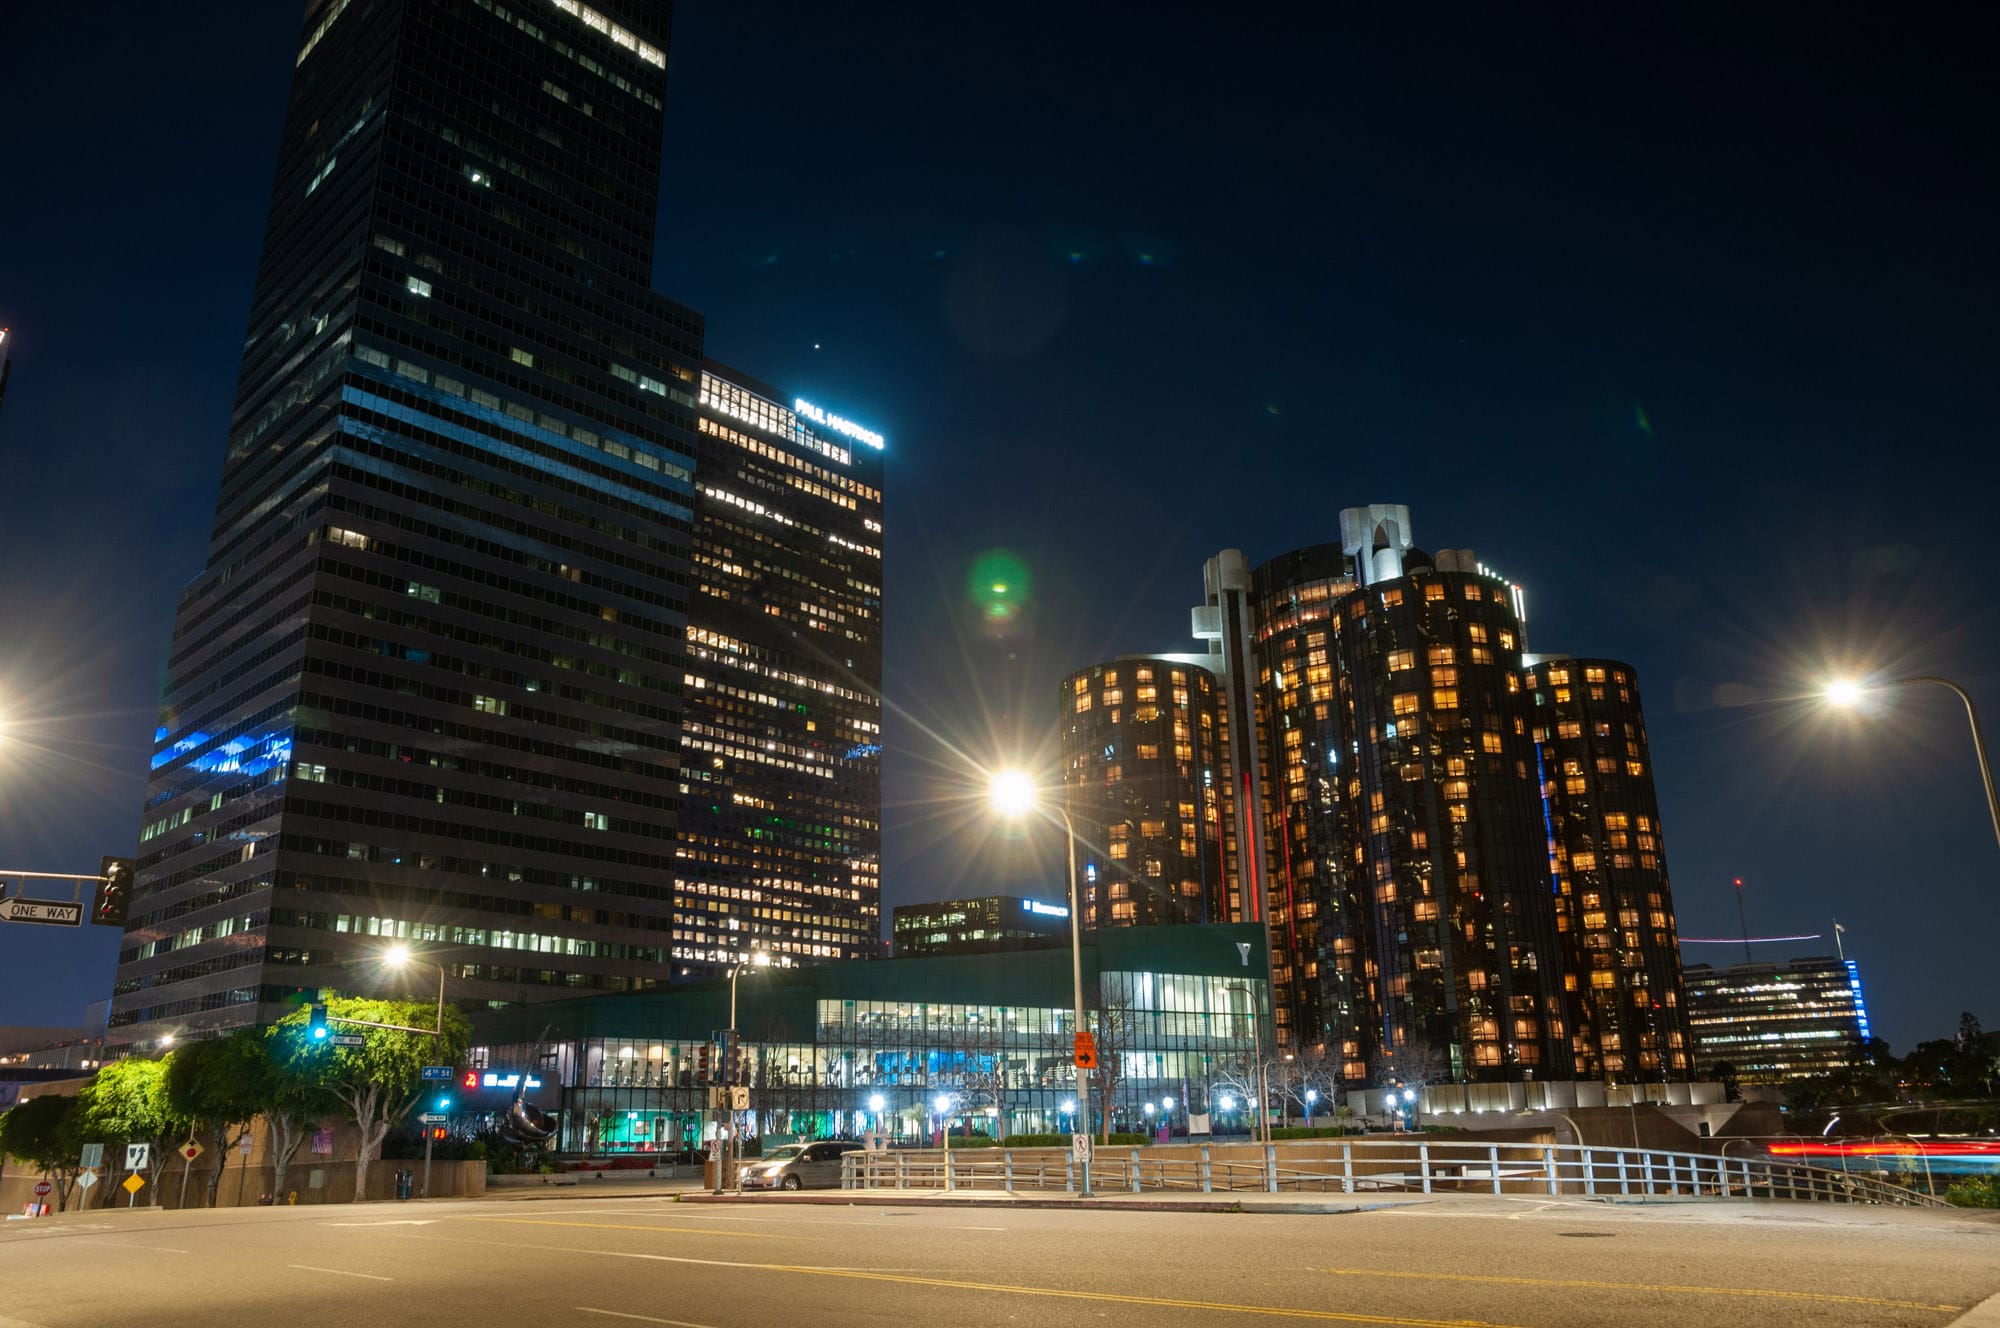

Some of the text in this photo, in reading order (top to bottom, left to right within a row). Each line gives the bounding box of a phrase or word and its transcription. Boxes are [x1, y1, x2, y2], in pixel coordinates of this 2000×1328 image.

[11, 904, 74, 919] ONE WAY
[1235, 942, 1251, 966] Y
[35, 1185, 51, 1193] STOP
